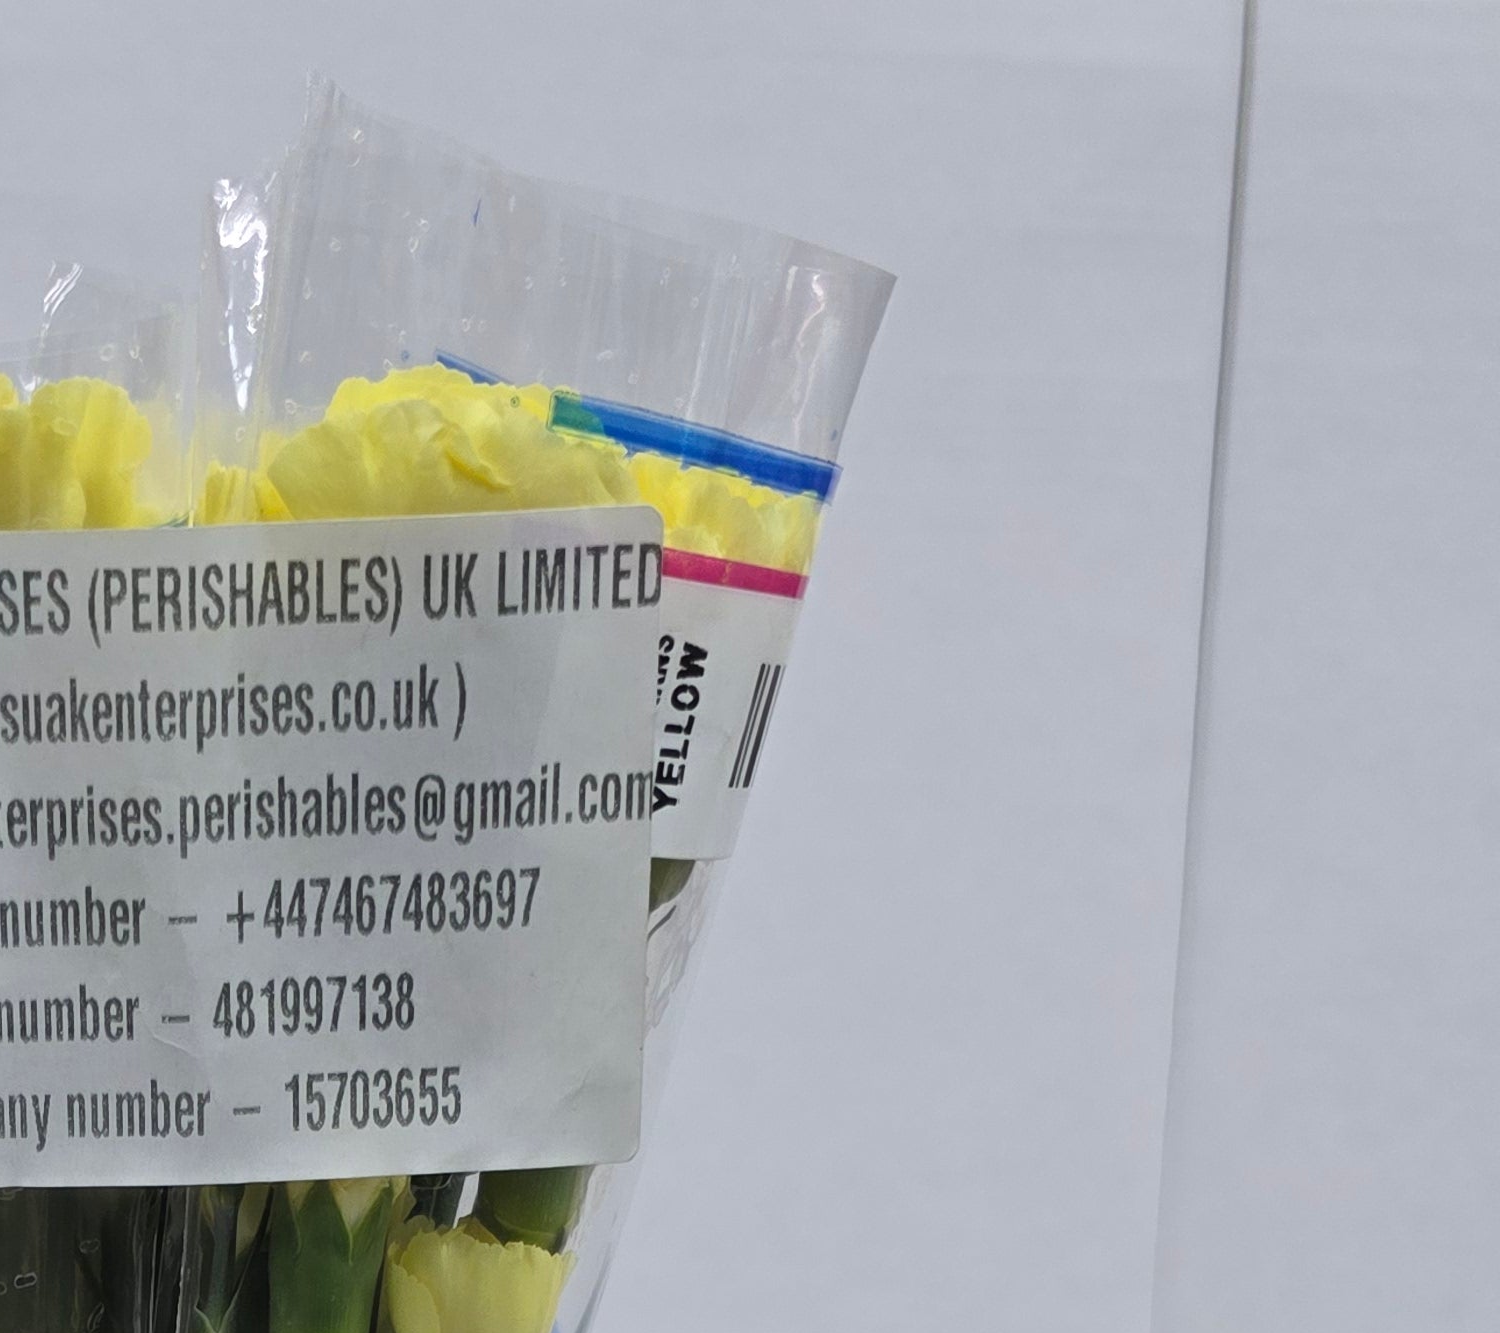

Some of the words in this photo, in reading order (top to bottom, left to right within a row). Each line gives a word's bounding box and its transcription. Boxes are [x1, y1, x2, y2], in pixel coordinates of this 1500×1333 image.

[88, 556, 402, 649] (PERISHABLES)
[424, 553, 478, 620] UK
[498, 543, 662, 616] LIMITED
[652, 640, 708, 814] YELLOW
[0, 886, 145, 948] number
[227, 867, 541, 944] +447467483697
[213, 972, 414, 1038] 481997138
[67, 1079, 210, 1138] number
[285, 1066, 462, 1132] 15703655
